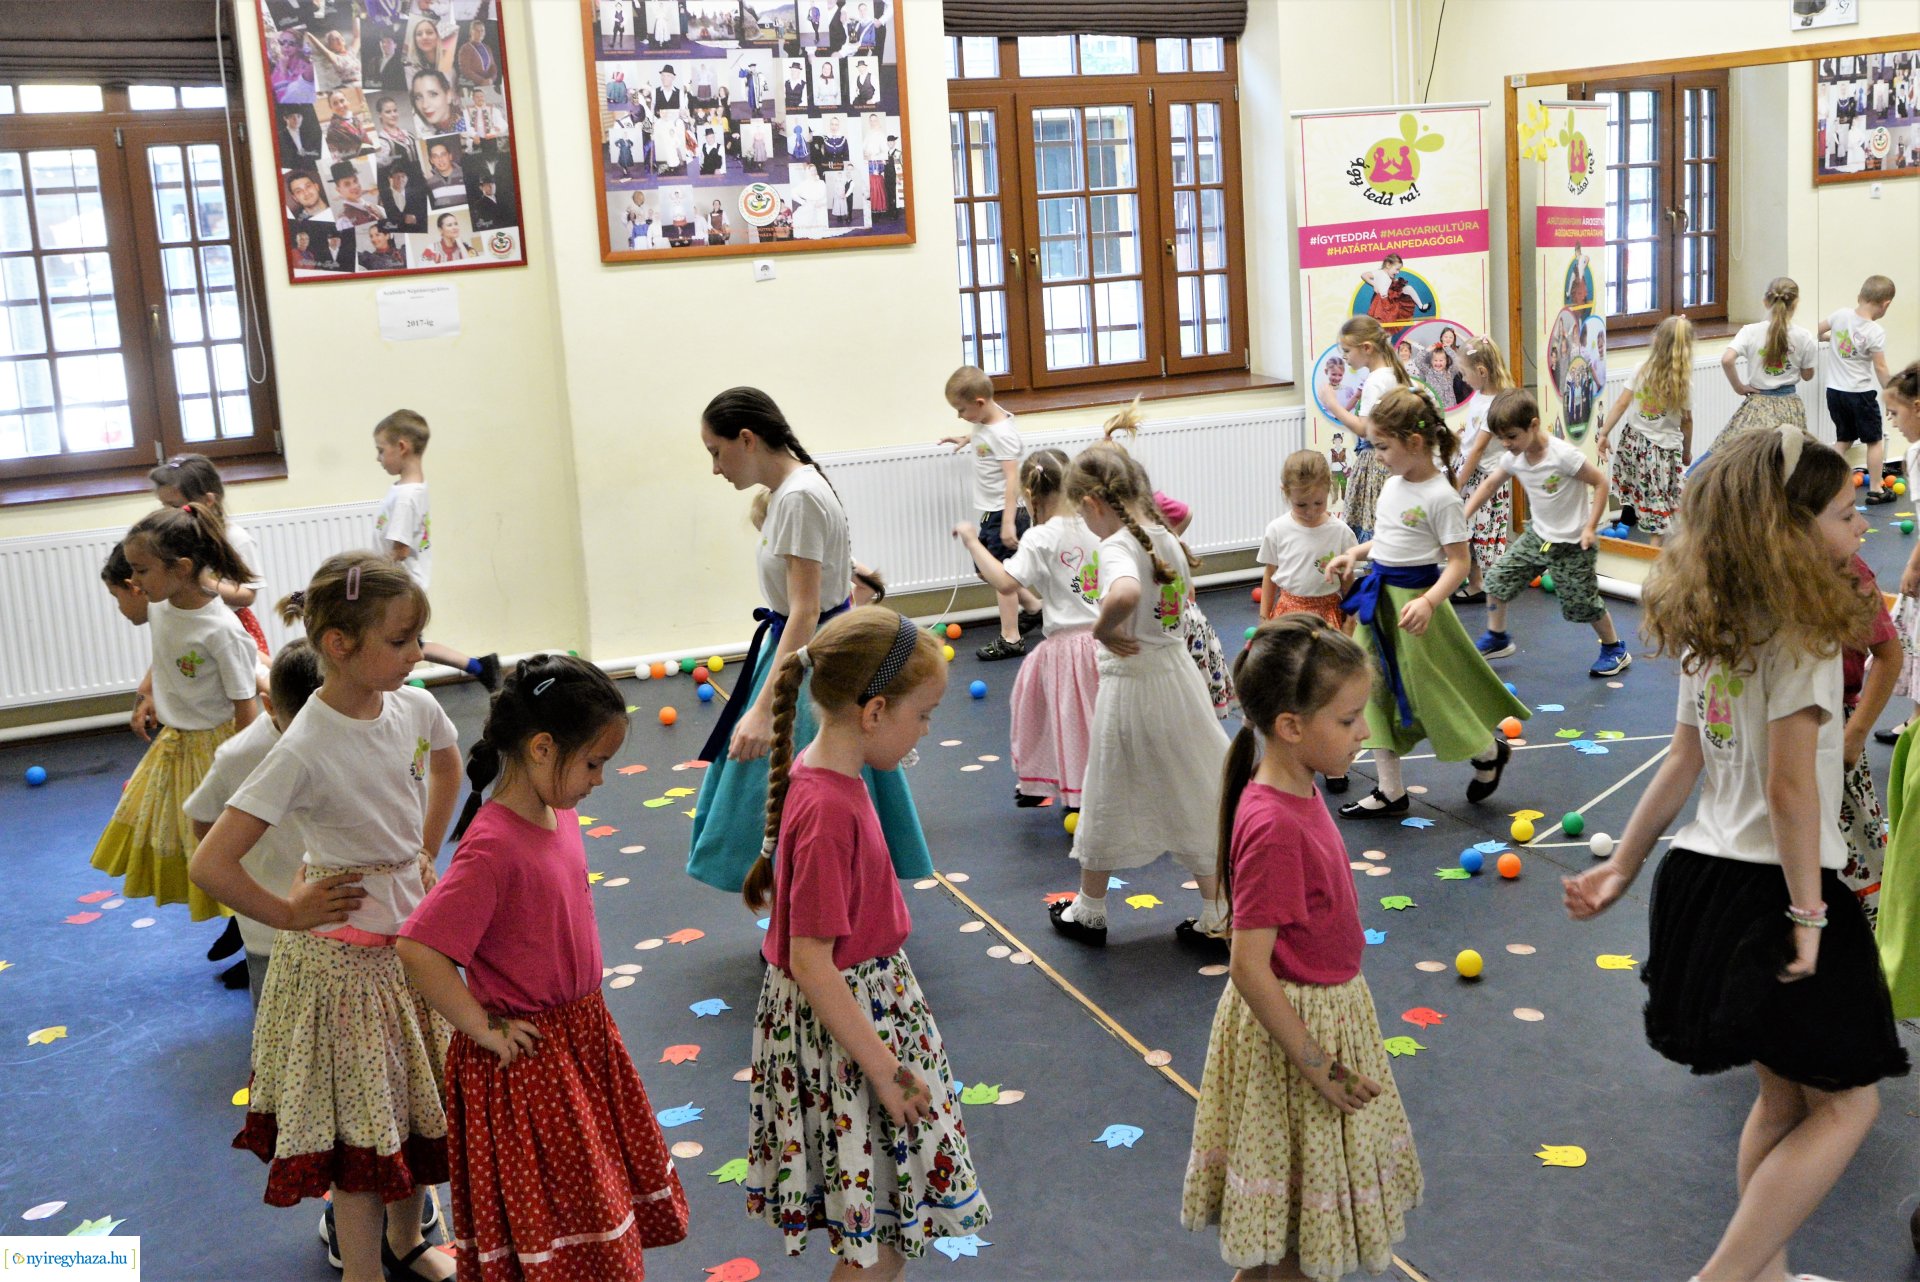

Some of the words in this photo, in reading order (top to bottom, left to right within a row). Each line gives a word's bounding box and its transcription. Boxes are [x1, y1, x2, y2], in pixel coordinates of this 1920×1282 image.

[1363, 187, 1394, 206] tedd
[1399, 182, 1421, 204] rá!
[1309, 228, 1378, 246] #ÍGYTEDDRÁ
[1380, 220, 1480, 239] #MAGYARKULTÚRA
[1327, 234, 1464, 256] #HATÁRTALANPEDAGÓGIA
